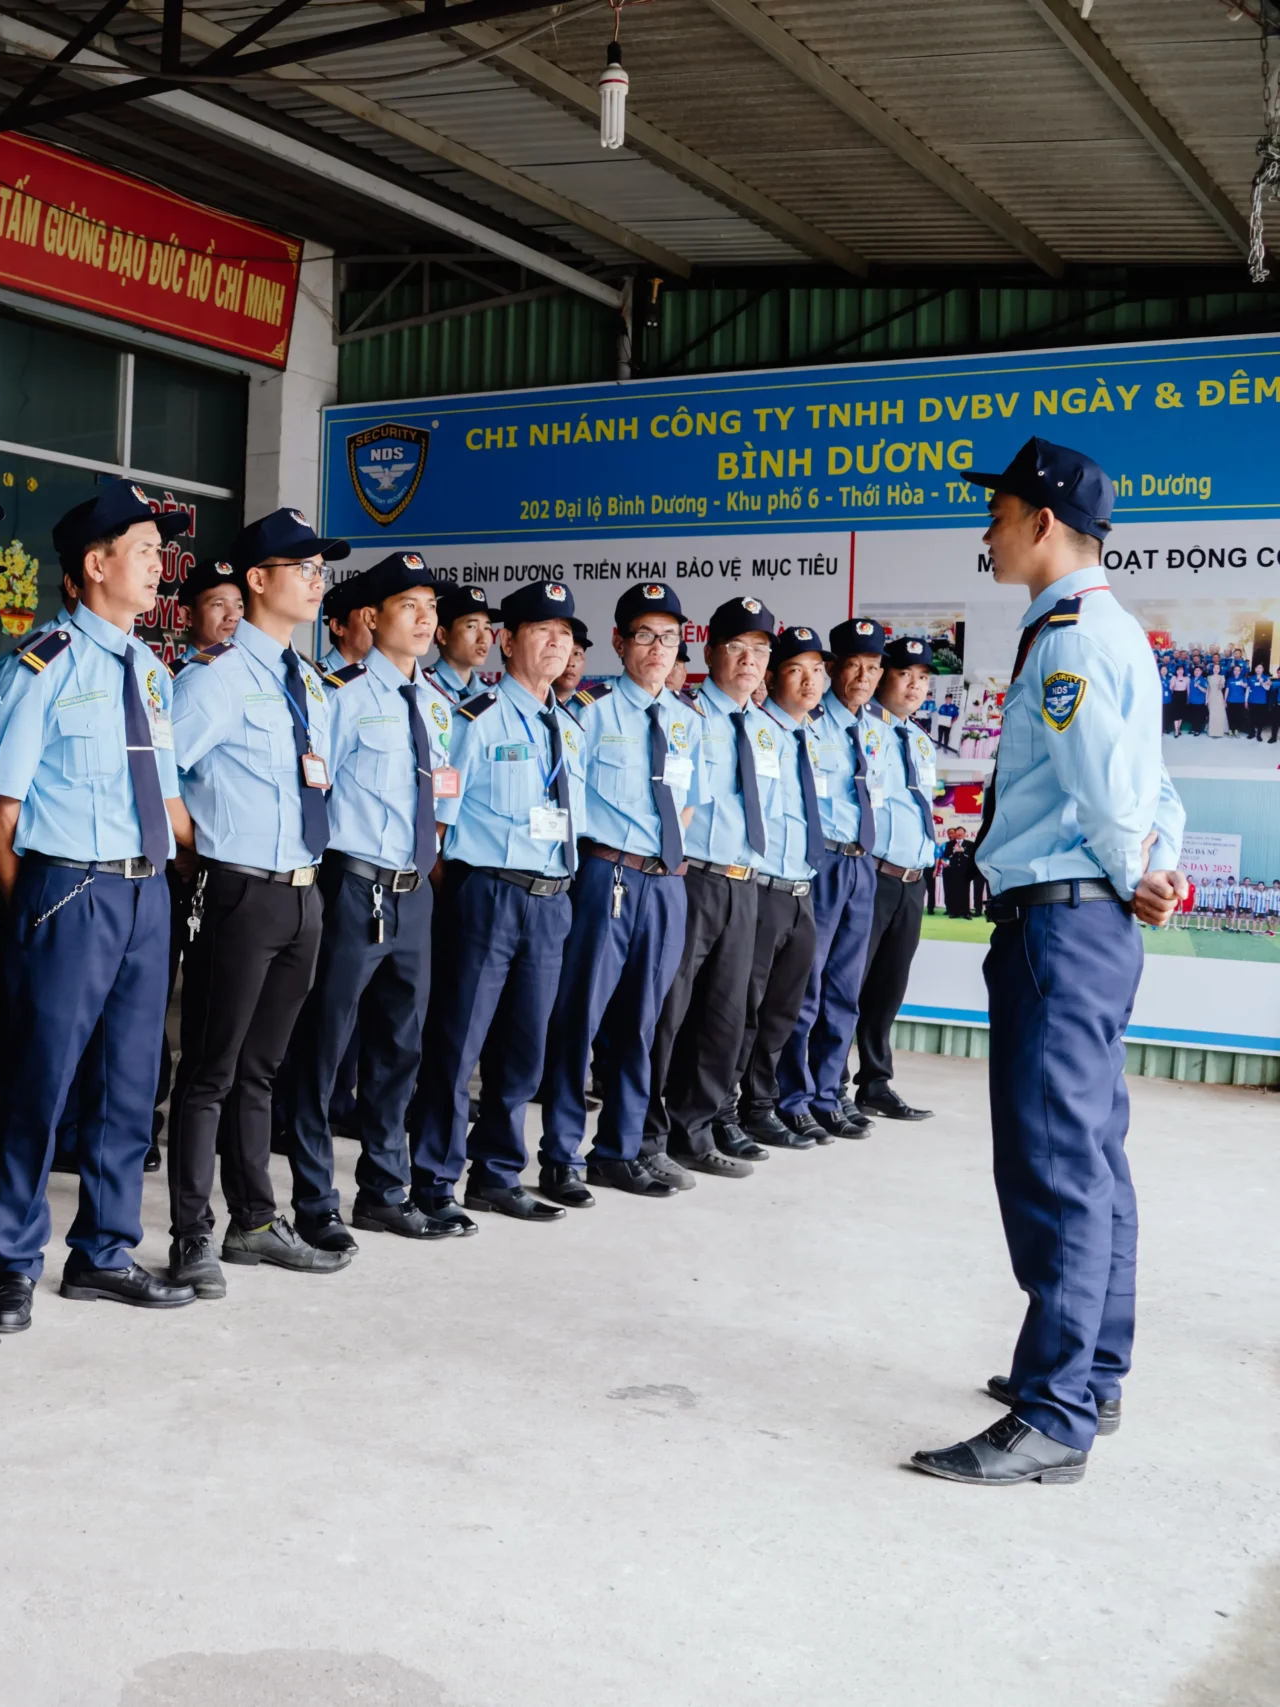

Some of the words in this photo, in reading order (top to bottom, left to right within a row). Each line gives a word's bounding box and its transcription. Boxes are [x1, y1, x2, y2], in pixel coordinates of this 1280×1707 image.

[43, 201, 108, 270] GƯƠNG
[107, 225, 148, 287] ĐẠO
[148, 232, 186, 295] ĐỨC
[187, 239, 216, 303] HỒ
[214, 259, 248, 313] CHÍ
[244, 273, 286, 327] MINH
[466, 426, 518, 450] CHI
[529, 413, 639, 446] NHÁNH
[650, 406, 741, 438] CÔNG
[753, 407, 795, 432] TY
[806, 400, 904, 429] TNHH
[919, 392, 1020, 422] DVBV
[1033, 378, 1142, 416] NGÀY
[1155, 382, 1185, 409] &
[1196, 369, 1280, 407] ĐÊM
[355, 427, 417, 447] SECURITY
[370, 447, 404, 461] NDS
[717, 441, 813, 480] BÌNH
[827, 438, 974, 476] DƯƠNG
[520, 500, 550, 520] 202
[555, 498, 581, 522] Đại
[587, 495, 603, 521] lộ
[607, 494, 645, 517] Bình
[651, 493, 707, 517] Dương
[726, 490, 761, 511] Khu
[767, 486, 803, 515] phố
[808, 487, 820, 509] 6
[839, 483, 880, 507] Thới
[887, 482, 924, 505] Hòa
[945, 482, 977, 504] TX.
[1141, 473, 1211, 499] Dương
[161, 543, 196, 584] ỨC
[463, 561, 500, 583] BÌNH
[503, 561, 565, 582] DƯƠNG
[574, 558, 621, 580] TRIỂN
[626, 561, 667, 579] KHAI
[676, 553, 714, 578] BẢO
[719, 555, 742, 582] VỆ
[751, 556, 792, 581] MỤC
[797, 553, 838, 577] TIÊU
[1103, 550, 1159, 575] OẠT
[1166, 545, 1247, 574] ĐỘNG
[683, 620, 710, 643] ÊM
[1051, 685, 1069, 695] NDS
[1190, 862, 1209, 872] DAY
[1212, 864, 1233, 873] 2022
